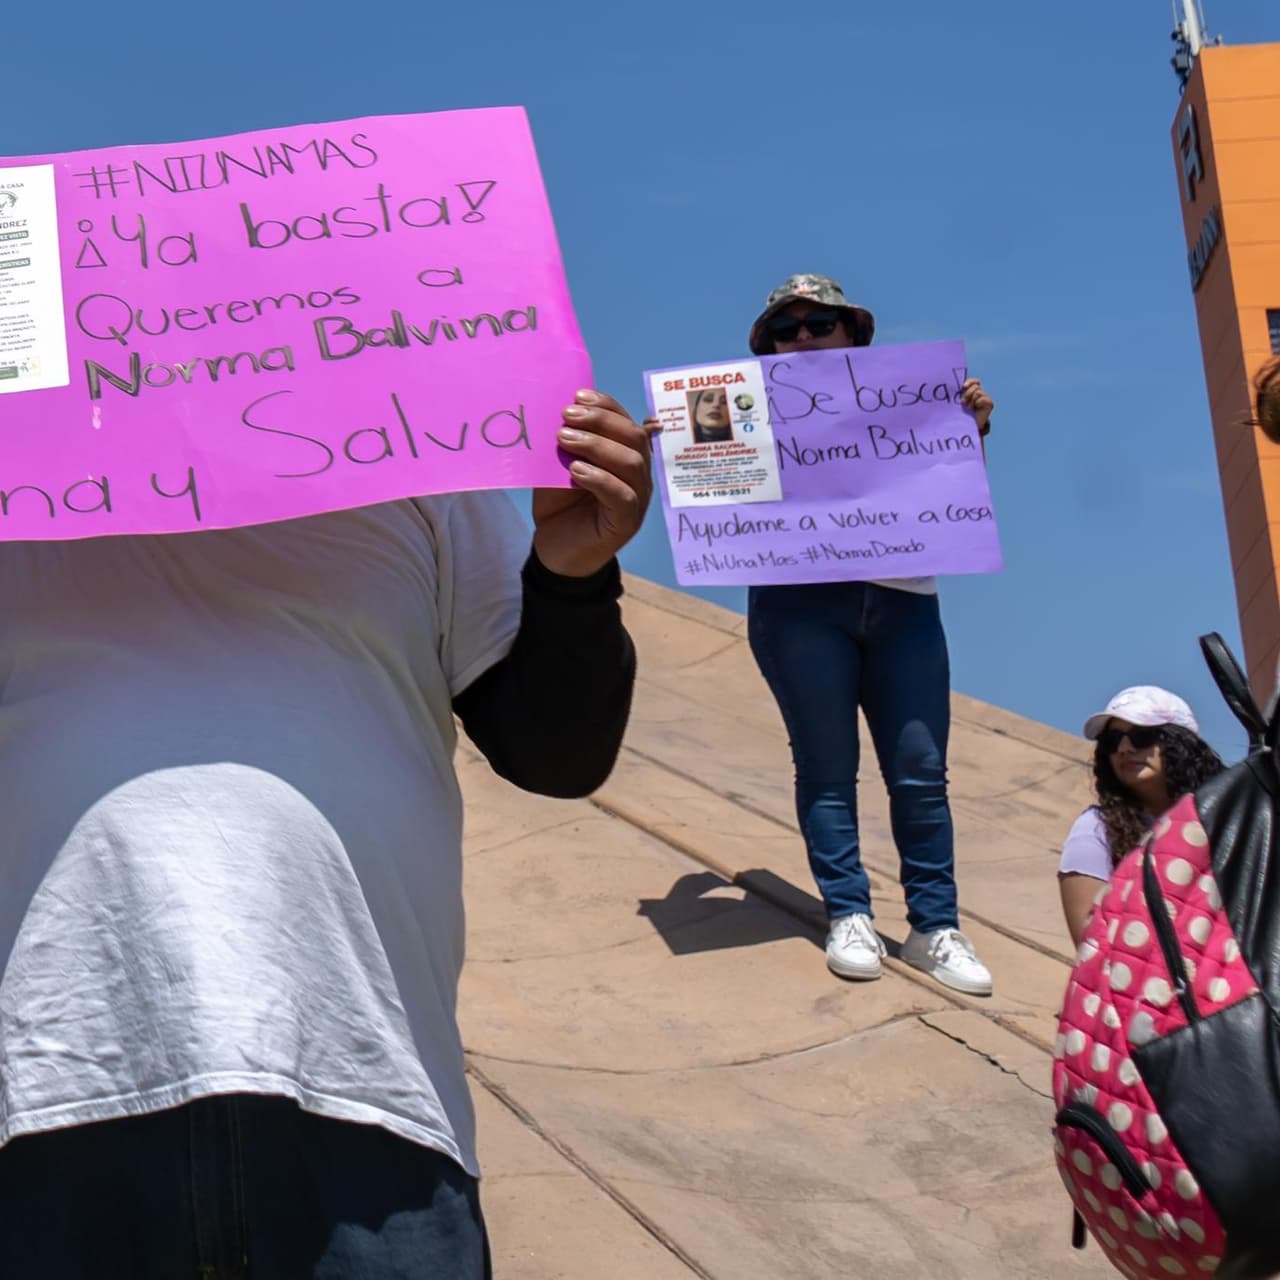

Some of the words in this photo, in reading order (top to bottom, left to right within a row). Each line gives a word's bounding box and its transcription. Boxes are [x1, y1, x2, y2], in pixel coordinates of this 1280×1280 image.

[76, 283, 362, 344] Queremos
[417, 267, 463, 289] a
[83, 342, 296, 401] Norma
[315, 306, 539, 362] Balvina
[664, 379, 684, 392] SE
[689, 371, 746, 388] BUSCA
[152, 467, 203, 522] y
[242, 391, 531, 480] Salva
[778, 440, 861, 470] Norma
[868, 425, 976, 461] Balvina
[678, 512, 789, 547] Ayudame
[799, 514, 818, 531] a
[828, 507, 899, 529] volver
[918, 508, 939, 523] a
